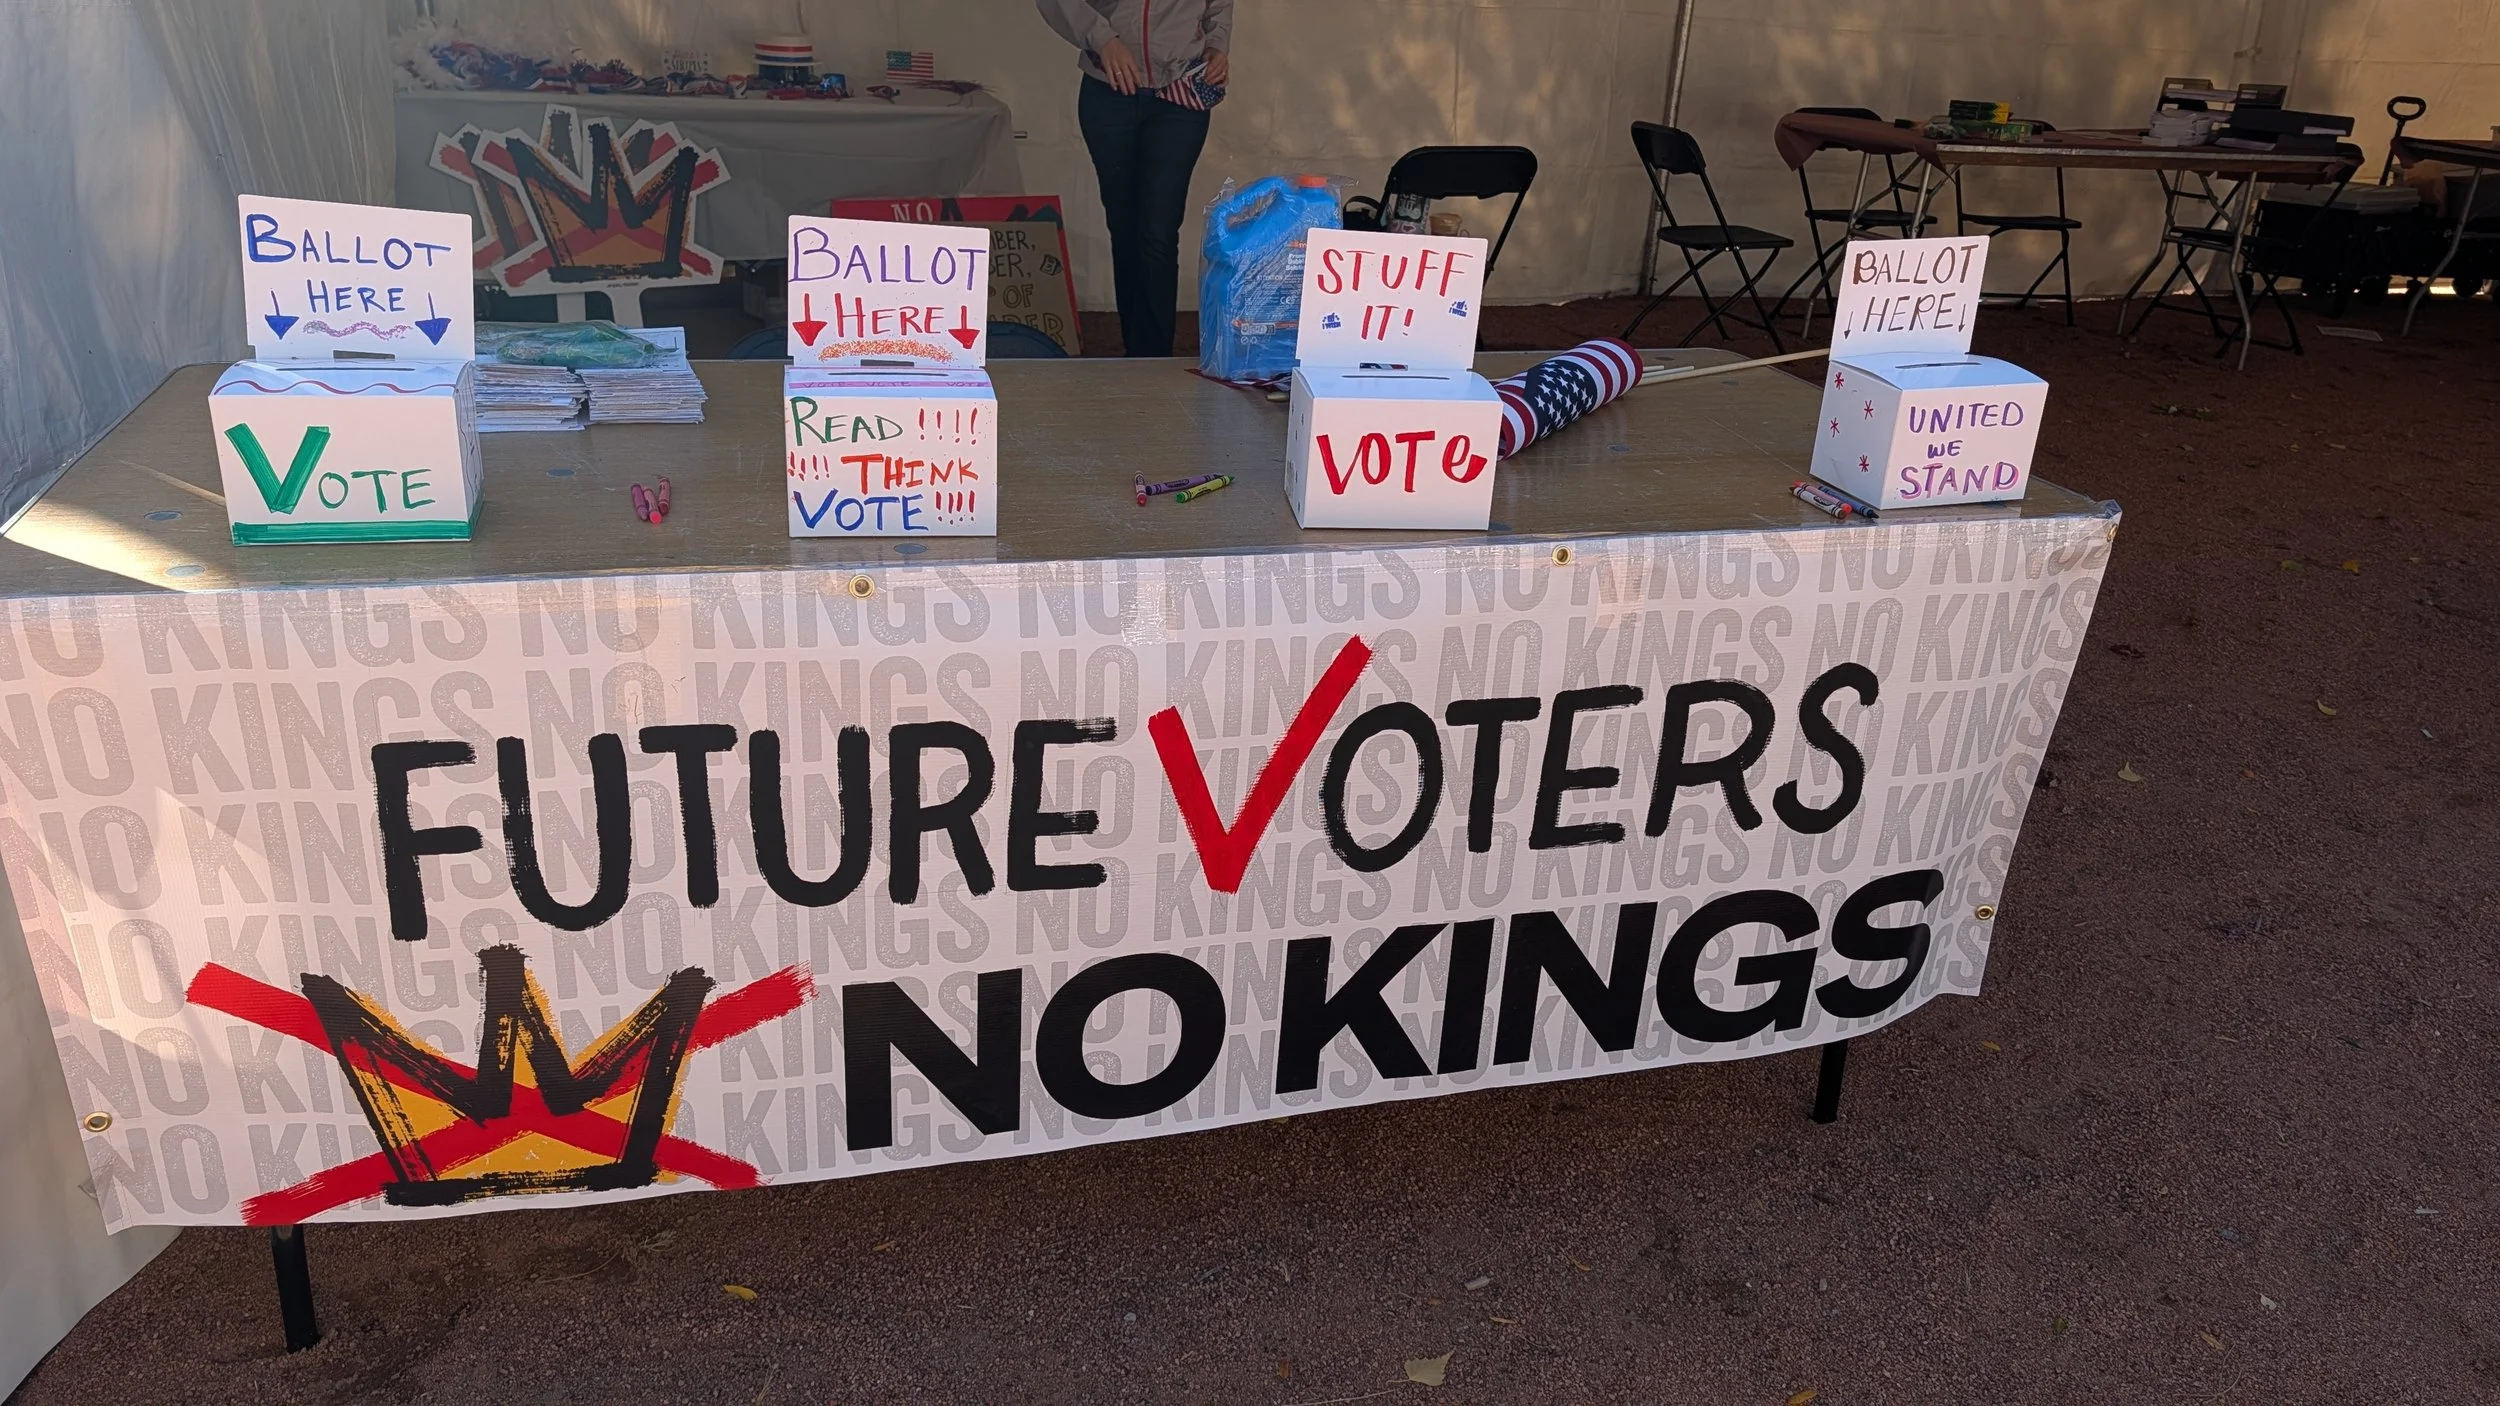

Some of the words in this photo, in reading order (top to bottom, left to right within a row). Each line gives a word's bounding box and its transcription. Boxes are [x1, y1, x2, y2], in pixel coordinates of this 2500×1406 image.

[246, 214, 451, 270] BALLOT
[788, 226, 987, 291] BALLOT
[990, 230, 1036, 253] BER,
[1852, 244, 1980, 285] BALLOT
[306, 279, 406, 314] HERE
[1317, 248, 1474, 298] STUFF
[834, 292, 945, 338] HERE
[1361, 304, 1414, 342] IT!
[1862, 291, 1957, 333] HERE
[790, 396, 904, 447] READ
[1908, 401, 2025, 434] UNITED
[224, 422, 436, 515] VOTE
[840, 453, 979, 495] THINK
[1898, 461, 2020, 499] STAND
[792, 487, 929, 532] VOTE
[1561, 604, 1793, 703] KINGS
[1909, 576, 2102, 684] KINGS
[1890, 673, 2071, 778] KINGS
[370, 716, 1118, 942] FUTURE
[1147, 634, 1880, 895] VOTERS
[1872, 752, 2041, 867] KINGS
[841, 951, 1227, 1152] NO
[1274, 868, 1945, 1096] KINGS
